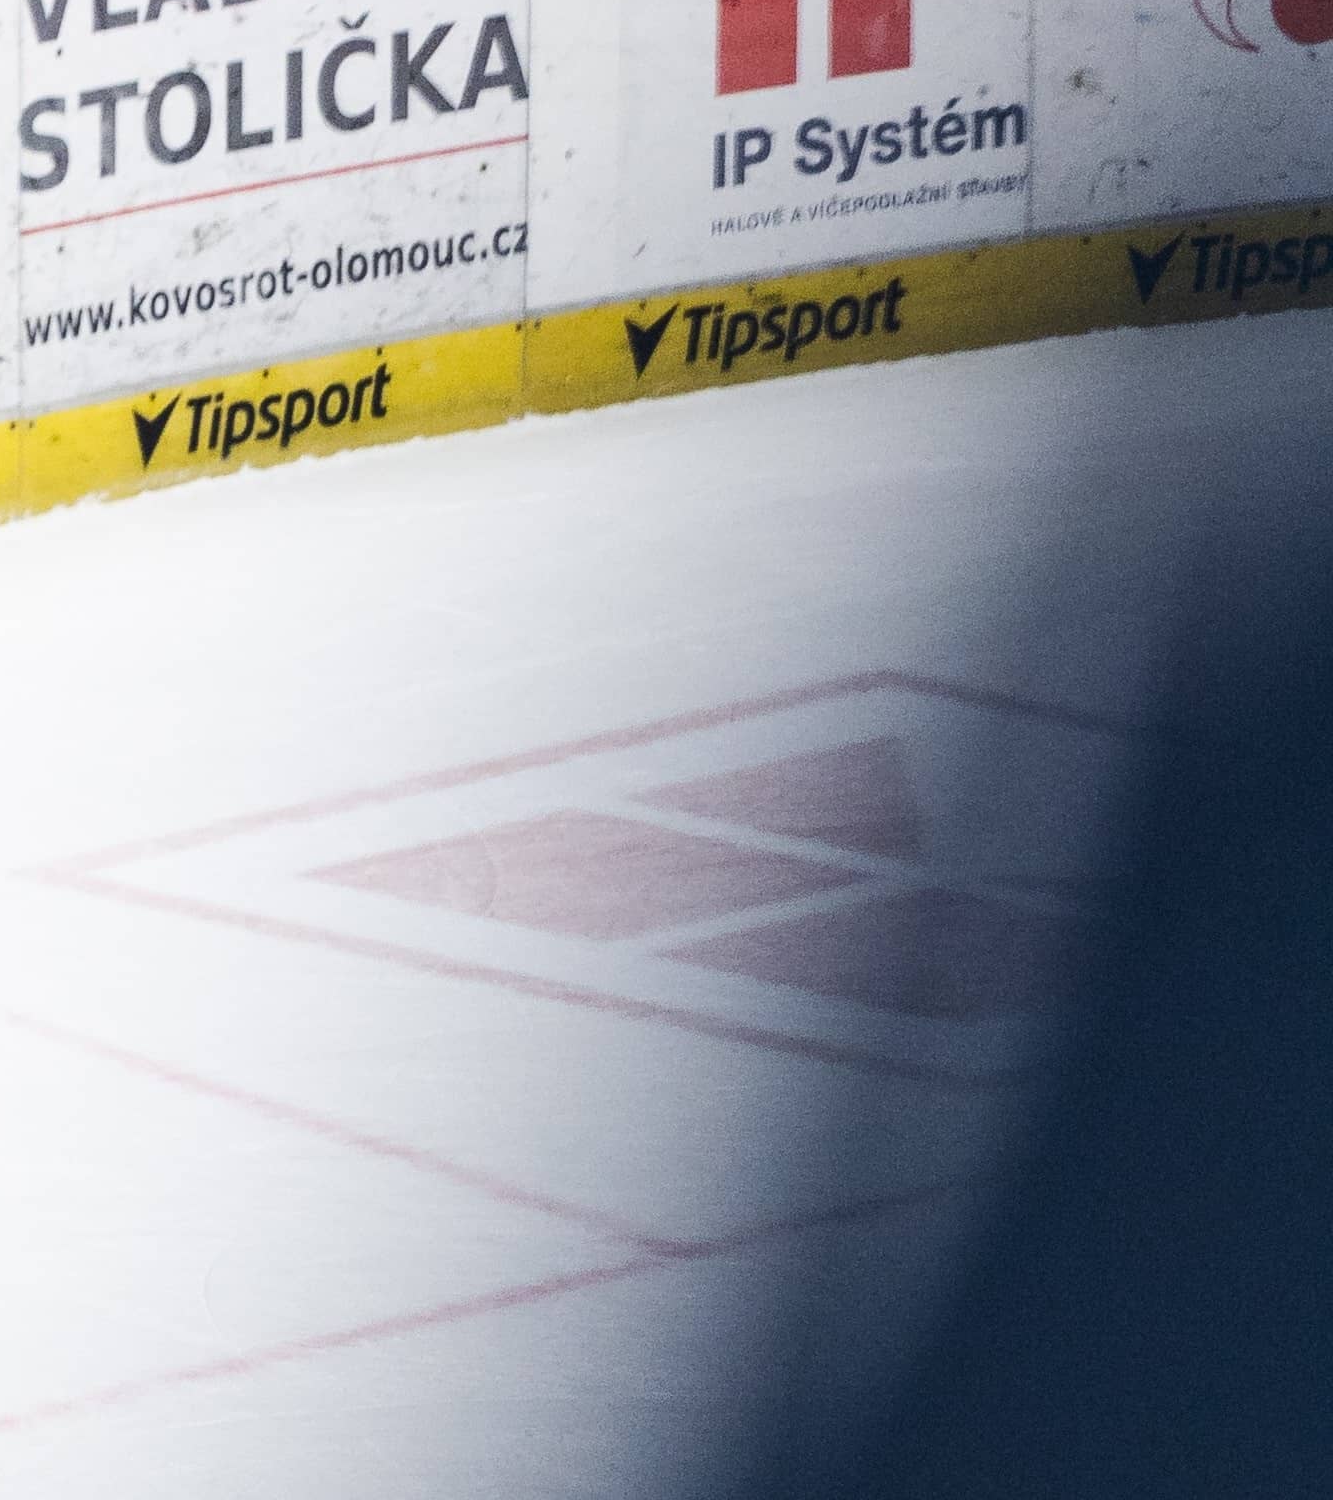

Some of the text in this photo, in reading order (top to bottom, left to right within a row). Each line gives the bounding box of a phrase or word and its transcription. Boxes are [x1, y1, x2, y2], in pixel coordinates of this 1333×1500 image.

[18, 10, 531, 194] STOLIČKA
[712, 96, 1029, 190] IP Systém
[23, 217, 530, 348] www.kovosrot-olomouc.cz
[681, 276, 909, 374] Tipsport
[185, 360, 393, 460] Tipsport
